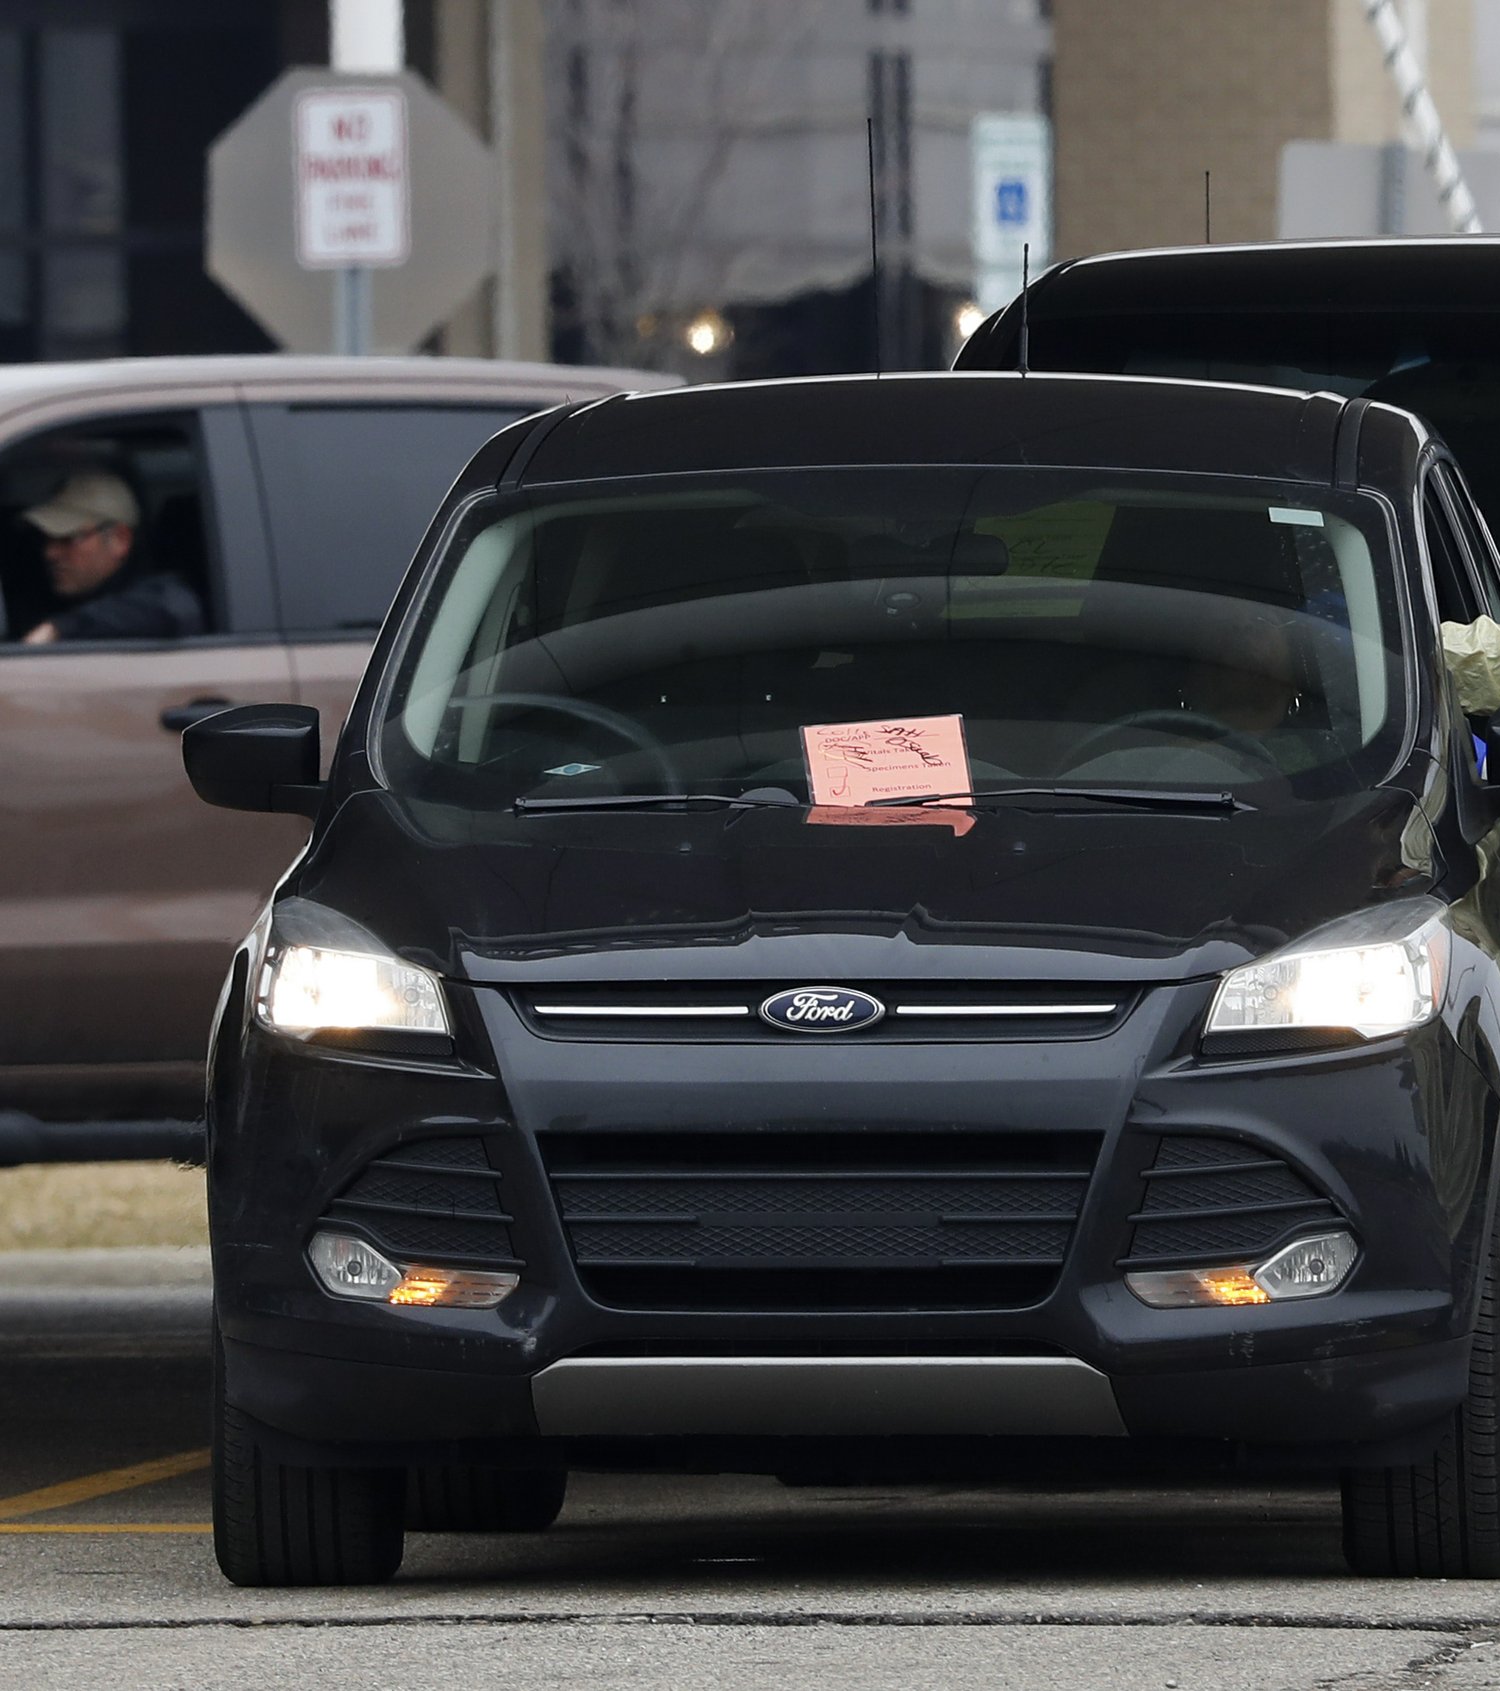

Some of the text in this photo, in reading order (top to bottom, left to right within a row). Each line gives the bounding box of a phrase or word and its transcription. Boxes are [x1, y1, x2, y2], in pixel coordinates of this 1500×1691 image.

[867, 763, 919, 772] Specimens
[872, 783, 932, 793] Registration
[786, 993, 855, 1021] Ford
